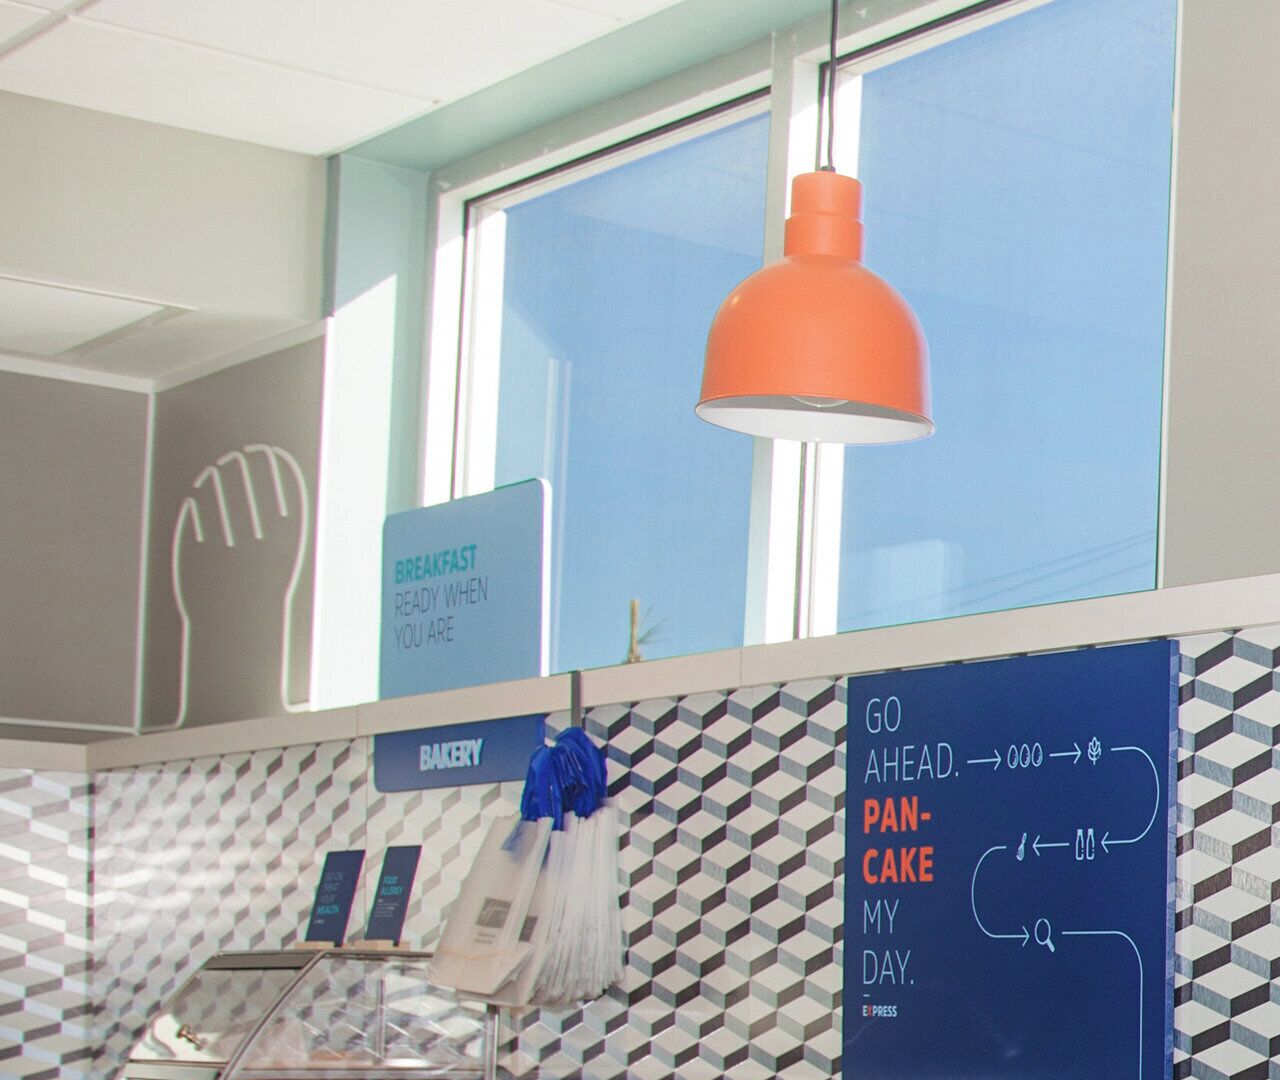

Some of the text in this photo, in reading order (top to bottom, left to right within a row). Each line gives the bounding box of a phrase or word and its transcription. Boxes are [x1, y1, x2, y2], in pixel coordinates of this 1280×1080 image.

[394, 543, 478, 585] BREAKFAST
[394, 576, 488, 618] READY WHEN
[393, 616, 455, 650] YOU ARE
[865, 695, 902, 734] GO
[420, 738, 483, 771] BAKERY
[864, 742, 960, 784] AHEAD.
[863, 796, 932, 834] PAN-
[862, 846, 935, 885] CAKE
[317, 904, 340, 914] HEALTH
[863, 898, 900, 934] MY
[863, 949, 914, 985] DAY.
[862, 1004, 898, 1017] EXPRESS
